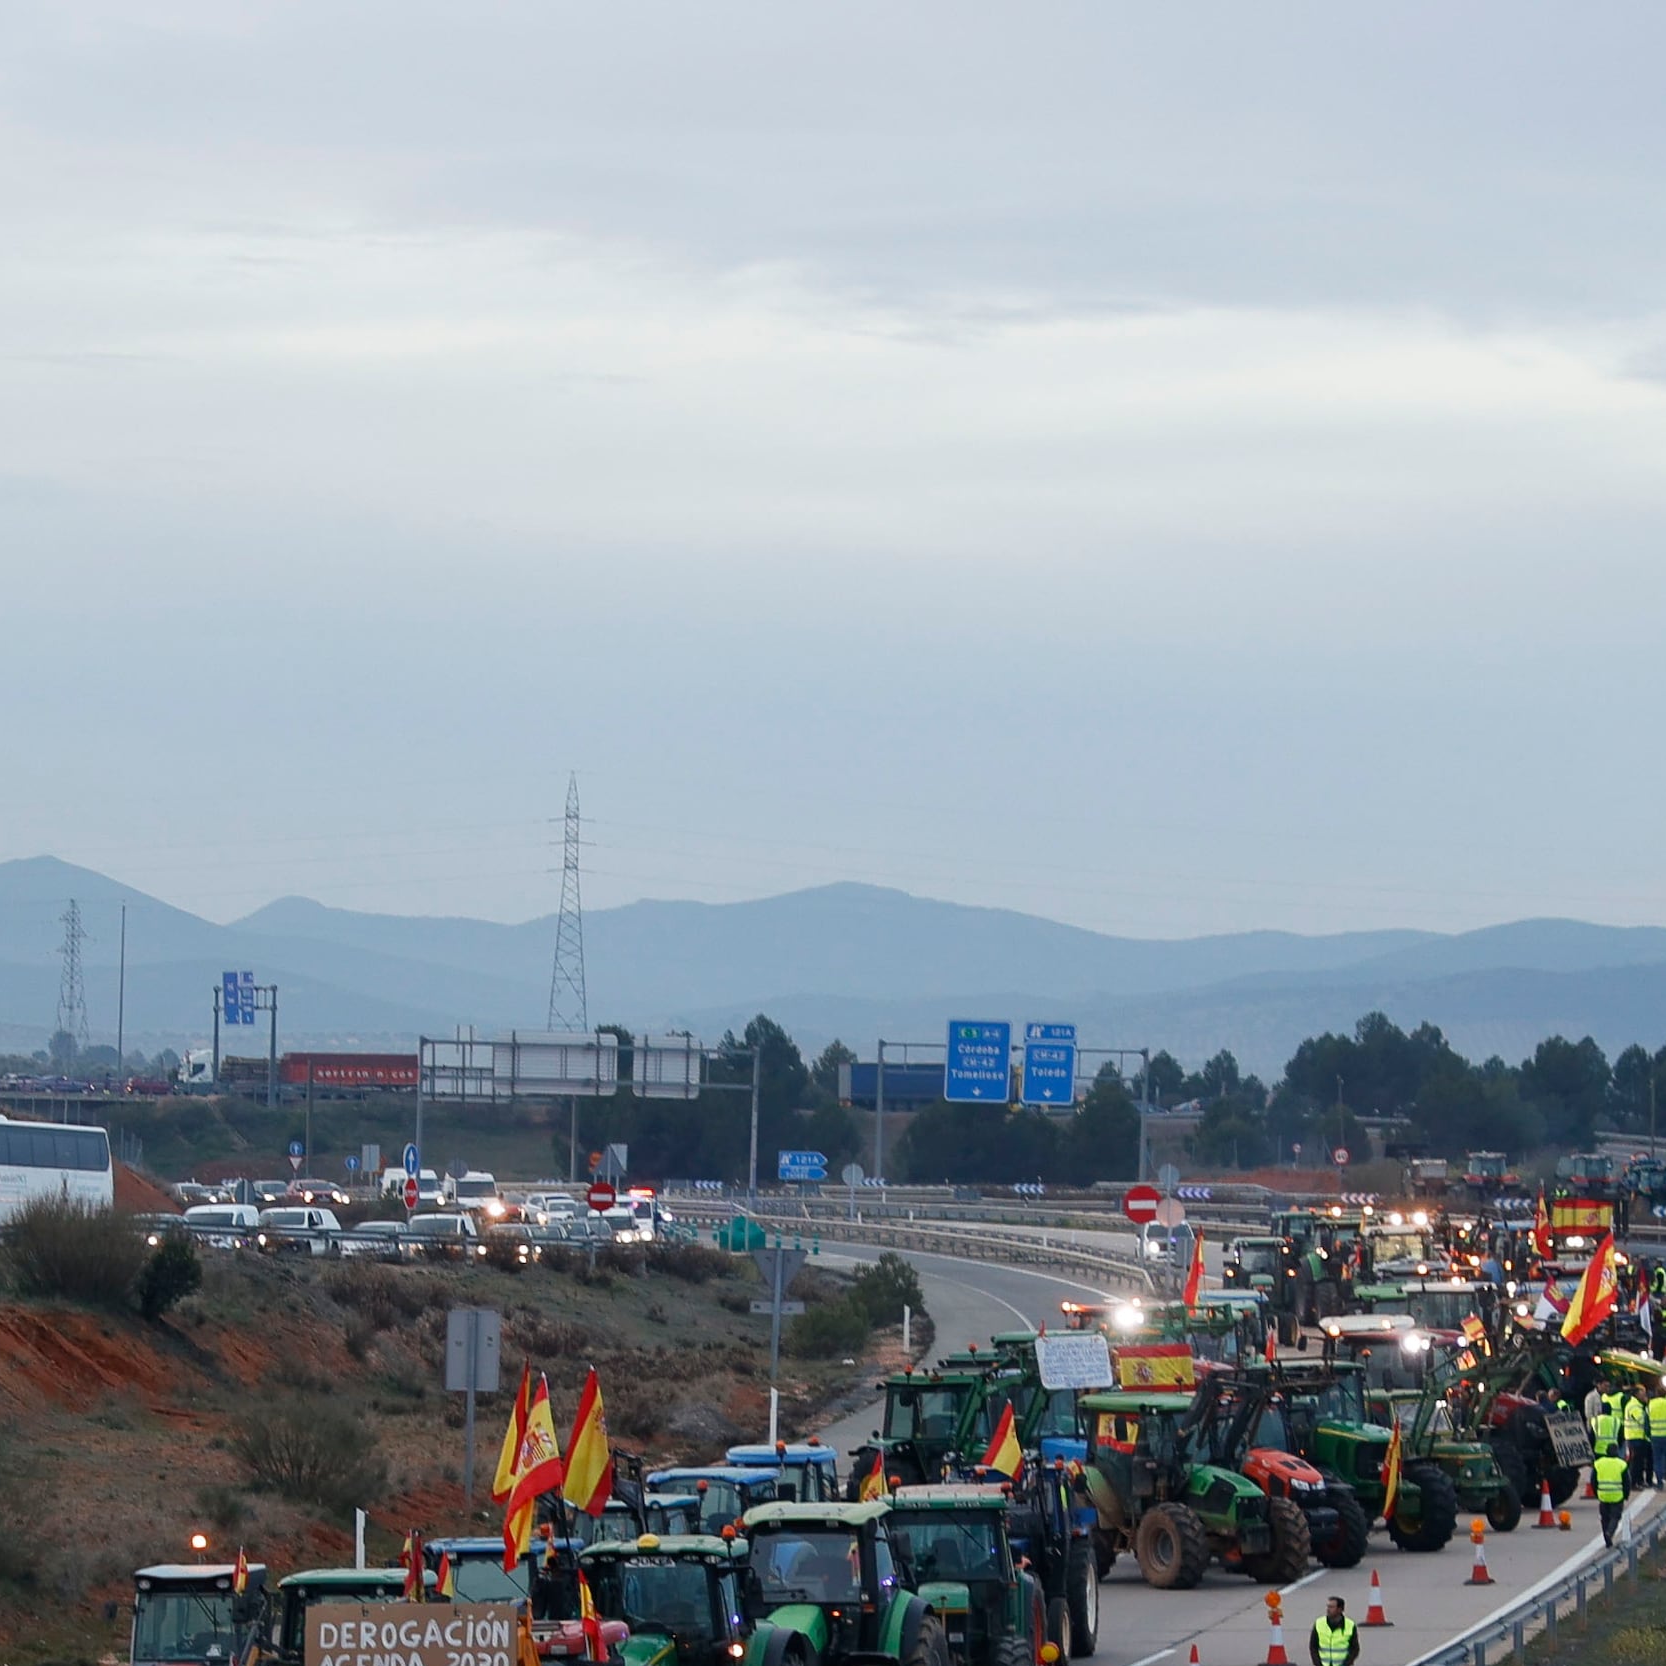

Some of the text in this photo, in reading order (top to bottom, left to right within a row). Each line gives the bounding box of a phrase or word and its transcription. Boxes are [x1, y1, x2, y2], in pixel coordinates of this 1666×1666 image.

[957, 1043, 1001, 1056] Córdoba
[951, 1068, 1005, 1081] Tomelloso
[1031, 1066, 1067, 1078] Toledo
[319, 1610, 509, 1650] DEROGACIÓN
